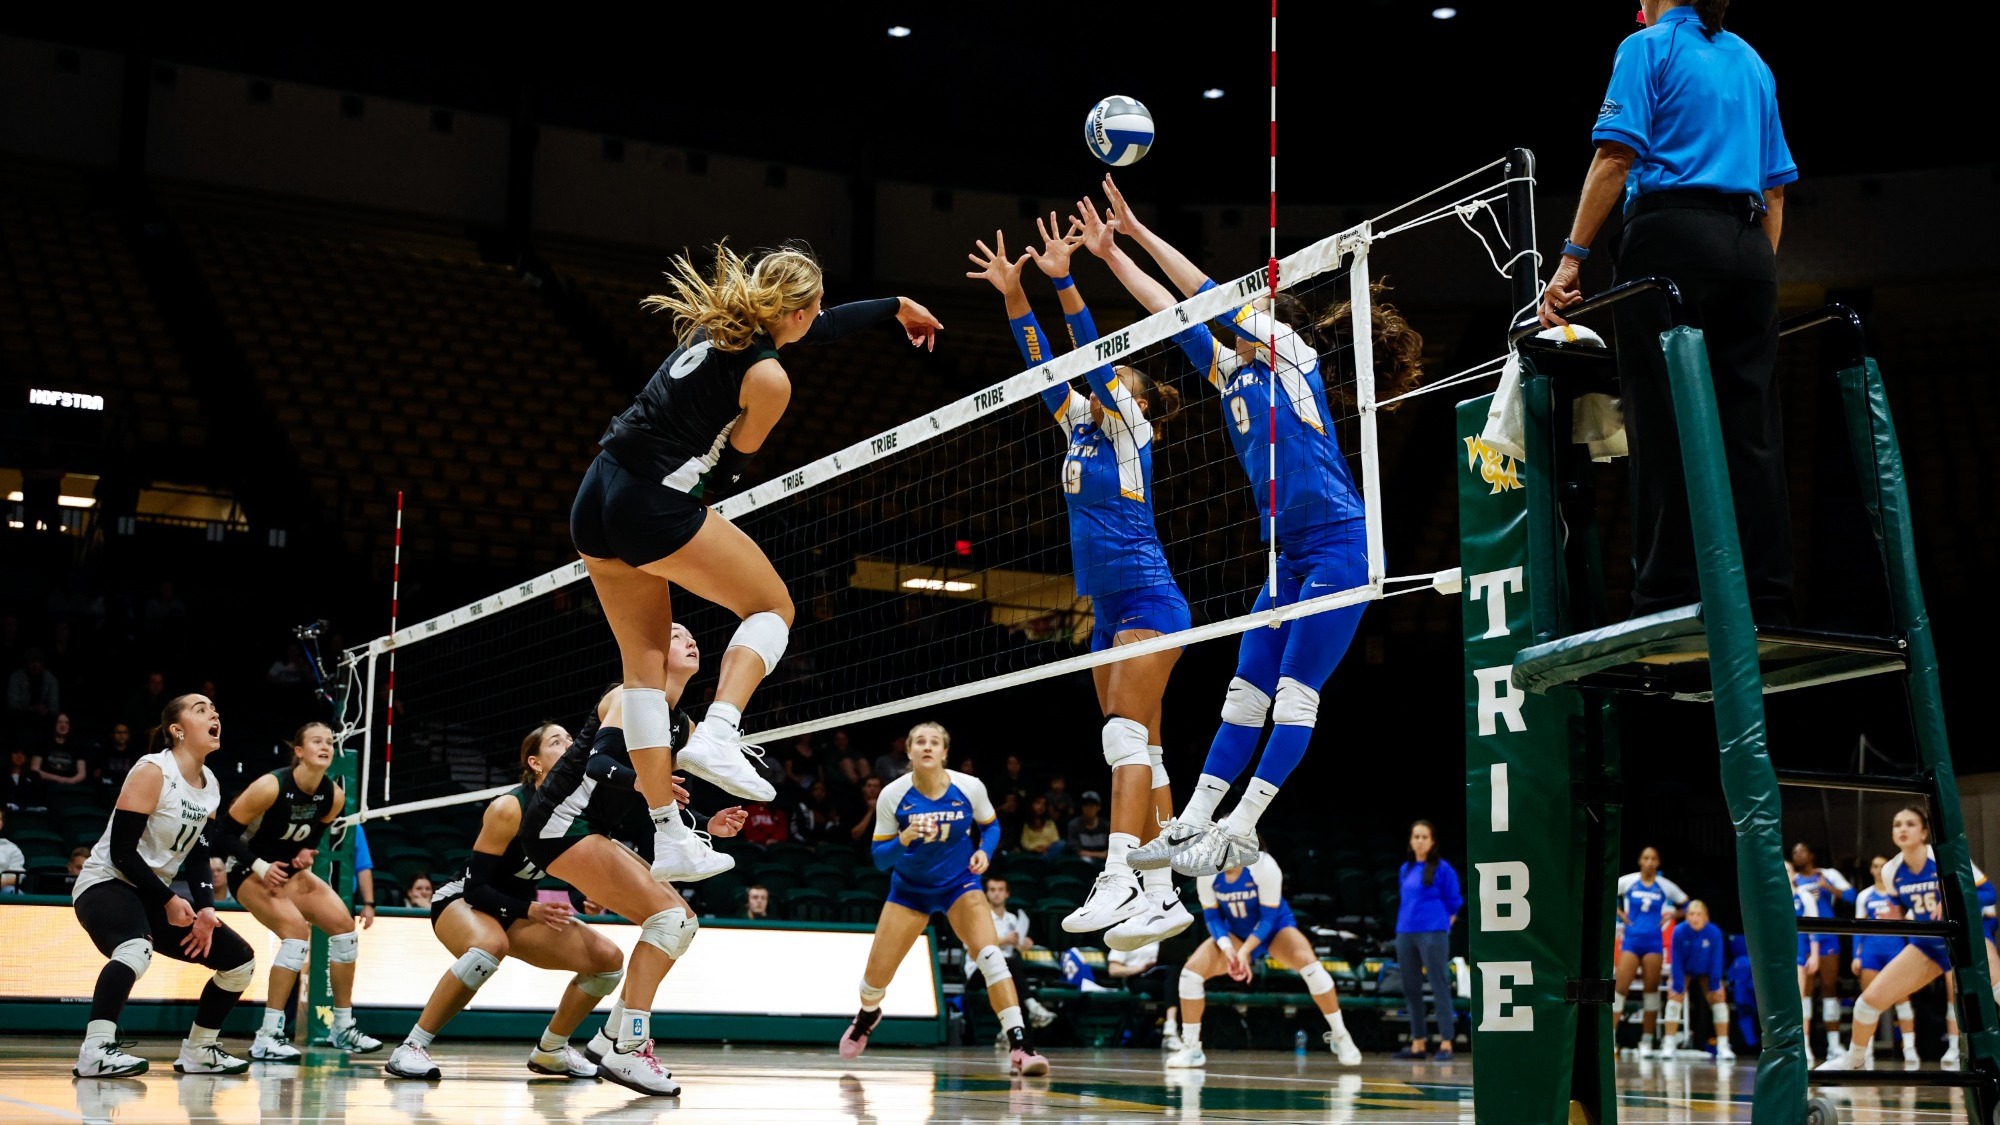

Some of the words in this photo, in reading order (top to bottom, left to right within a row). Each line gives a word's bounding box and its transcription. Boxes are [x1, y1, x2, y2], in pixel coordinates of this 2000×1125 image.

[1094, 106, 1105, 145] molten
[1023, 326, 1043, 363] PRIDE
[1095, 331, 1131, 362] TRIBE
[973, 386, 1004, 413] TRIBE
[1230, 396, 1251, 436] 9
[871, 432, 898, 456] TRIBE
[782, 471, 804, 493] TRIBE
[1469, 565, 1535, 1033] TRIBE
[169, 823, 198, 852] 11
[279, 823, 311, 843] 10
[1227, 901, 1248, 919] 11
[1909, 892, 1939, 915] 26
